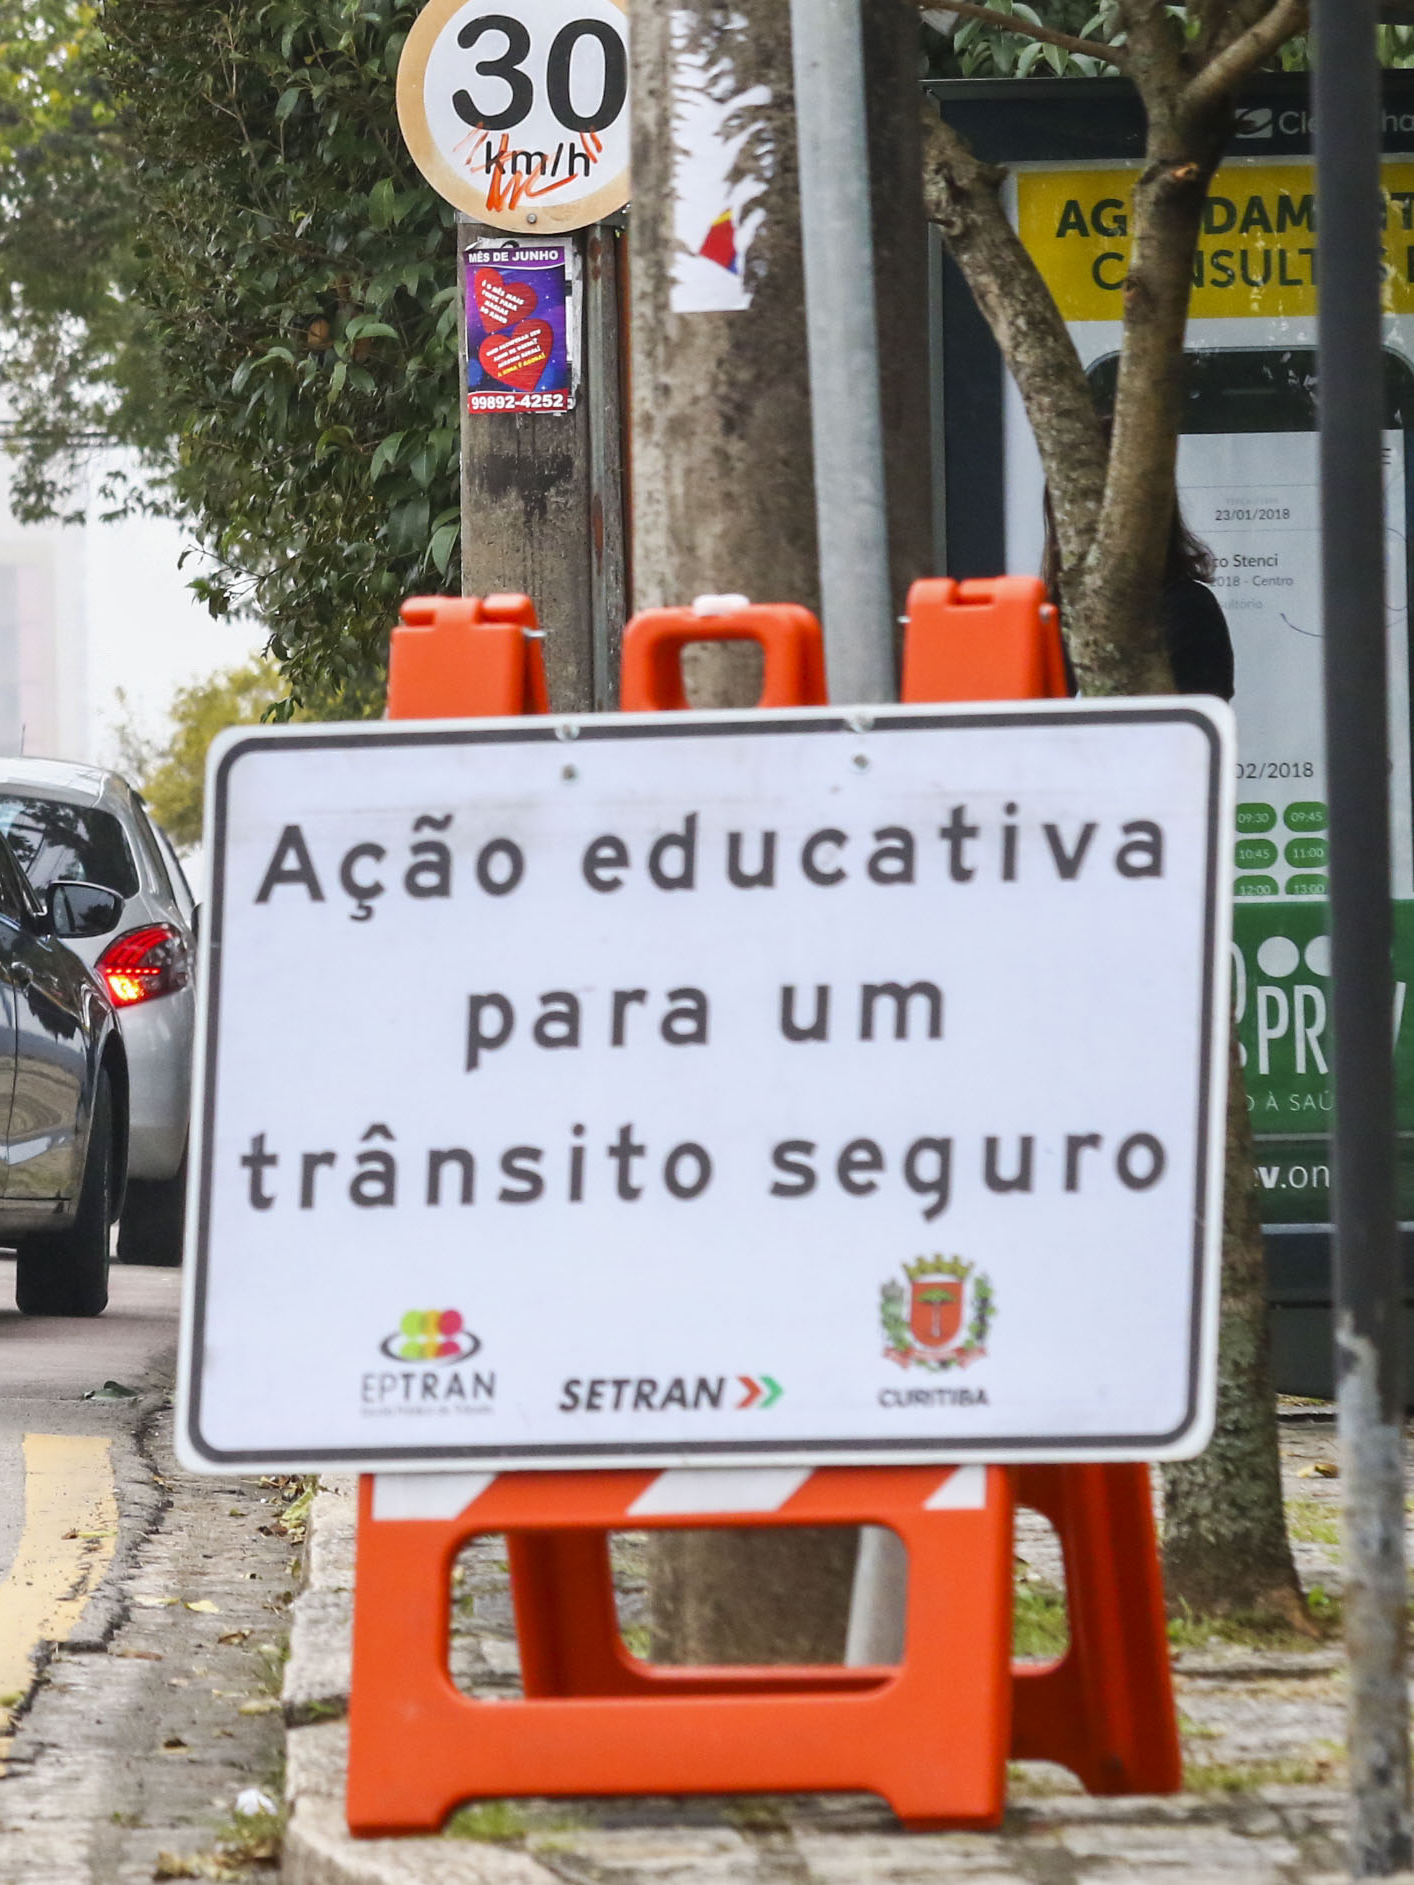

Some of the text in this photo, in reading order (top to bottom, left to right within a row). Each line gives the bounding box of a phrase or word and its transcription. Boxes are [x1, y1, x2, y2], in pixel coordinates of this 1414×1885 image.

[452, 14, 628, 133] 30
[485, 141, 590, 177] km/h
[468, 250, 559, 263] MÊS DE JUNHO
[471, 393, 564, 410] 99892-4252
[1215, 508, 1290, 521] 23/01/2018
[1233, 553, 1279, 567] Stenci
[1252, 575, 1294, 587] Centro
[1237, 811, 1323, 824] 09:30 09:45
[255, 801, 1164, 922] Ação educativa
[1239, 847, 1324, 860] 10:45 11:00
[465, 980, 944, 1073] para um
[1290, 1090, 1334, 1111] SAÚ
[241, 1123, 1167, 1222] trânsito seguro
[361, 1370, 497, 1402] EPTRAN
[559, 1377, 725, 1412] SETRAN
[878, 1387, 989, 1408] CURITIBA
